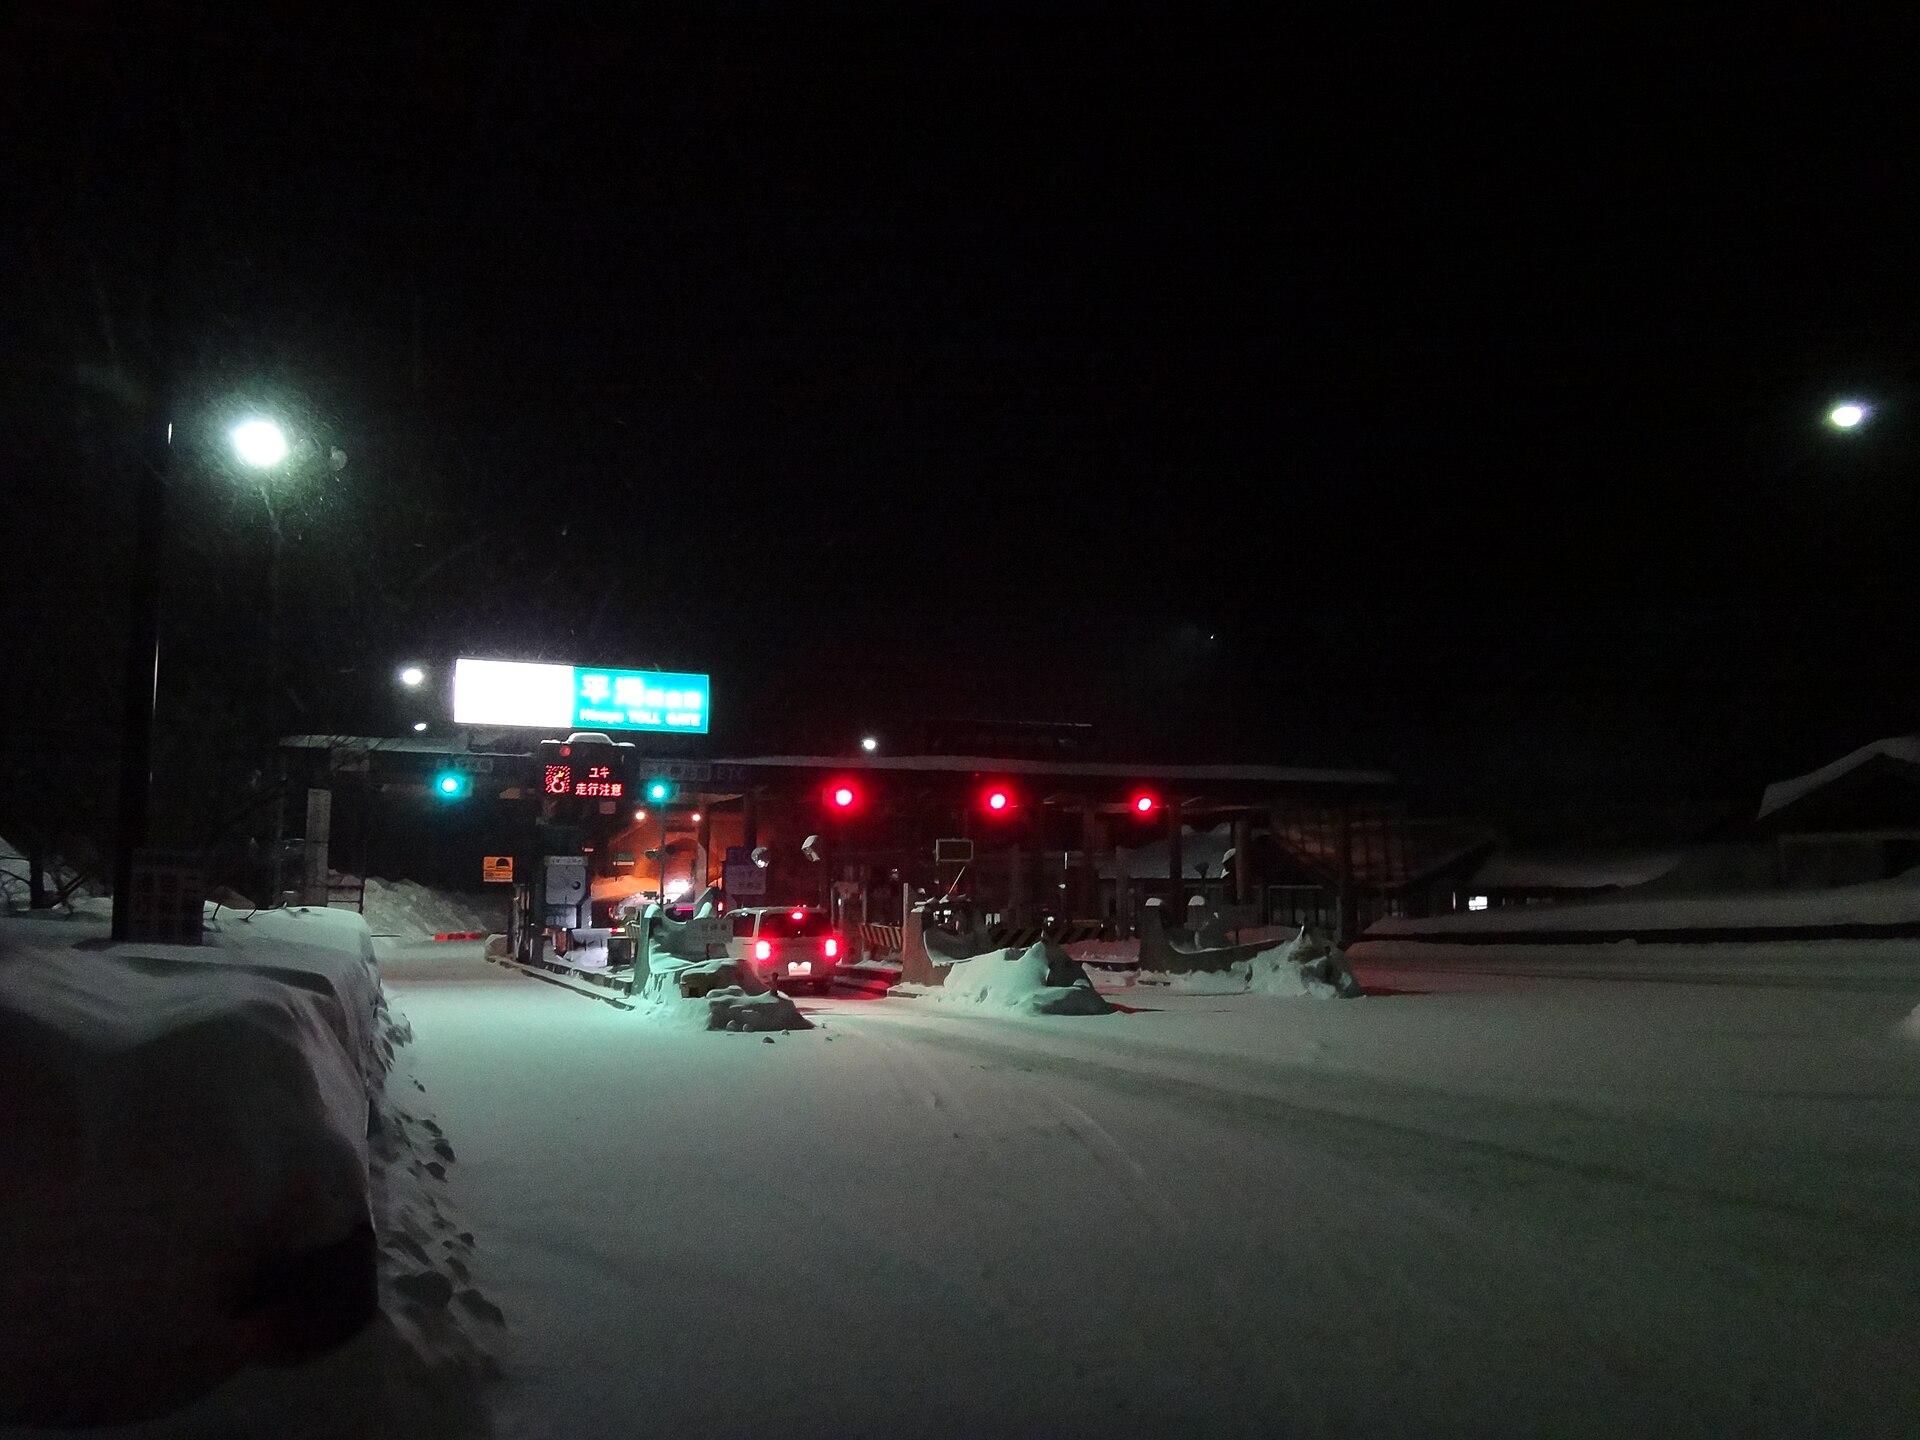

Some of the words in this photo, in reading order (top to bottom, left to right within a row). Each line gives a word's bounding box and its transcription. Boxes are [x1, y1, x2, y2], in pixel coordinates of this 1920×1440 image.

[627, 710, 662, 725] TOLL
[665, 712, 701, 726] GATE
[588, 766, 610, 778] ユキ
[575, 782, 623, 796] 走行注意
